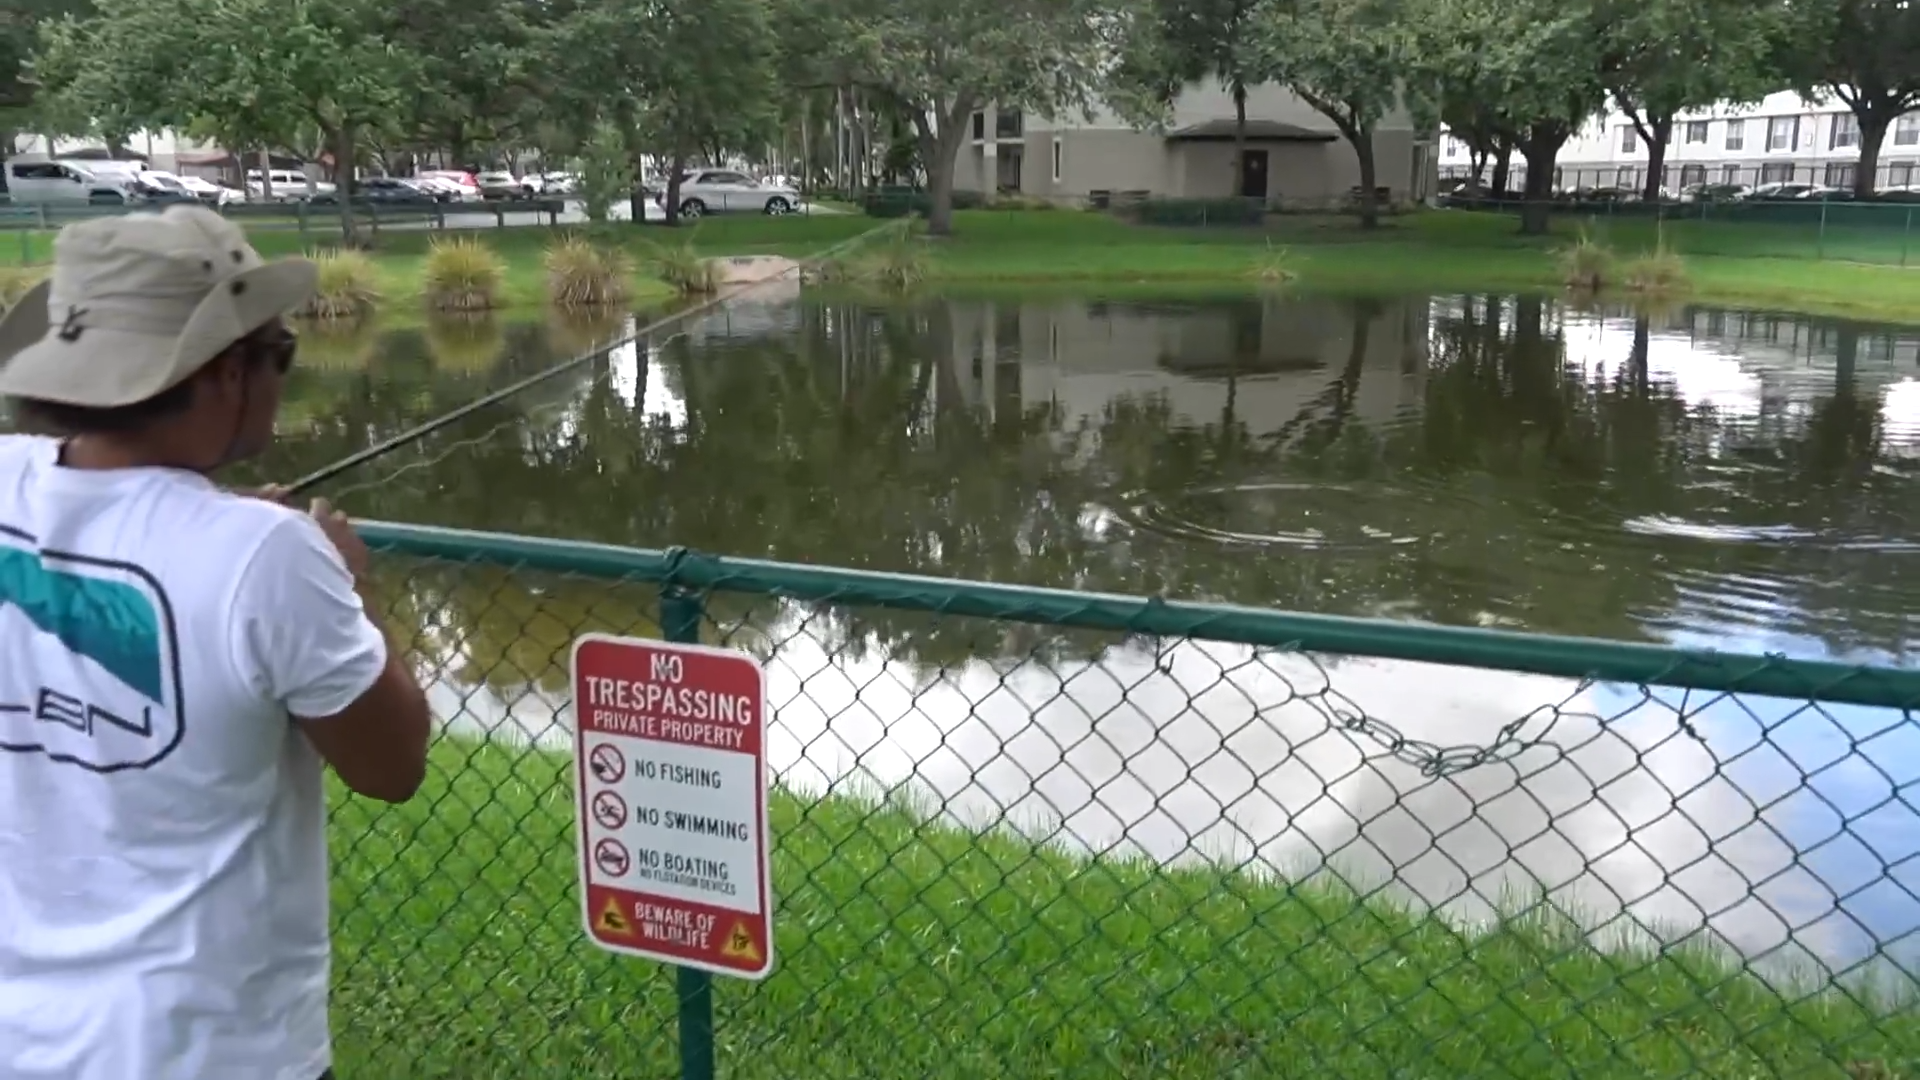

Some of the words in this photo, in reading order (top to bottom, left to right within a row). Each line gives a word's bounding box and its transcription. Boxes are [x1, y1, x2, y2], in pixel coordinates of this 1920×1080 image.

[650, 652, 683, 684] NO
[585, 676, 752, 726] TRESPASSING
[593, 709, 658, 736] PRIVATE
[661, 717, 744, 749] PROPERTY
[634, 759, 656, 779] NO
[660, 762, 722, 789] FISHING
[636, 806, 659, 826] NO
[664, 810, 749, 842] SWIMMING
[639, 848, 660, 868] NO
[664, 852, 729, 880] BOATING
[700, 877, 736, 897] DEVICES
[634, 902, 692, 928] BEWARE
[697, 913, 717, 932] OF
[642, 922, 710, 950] WILDLIFE
